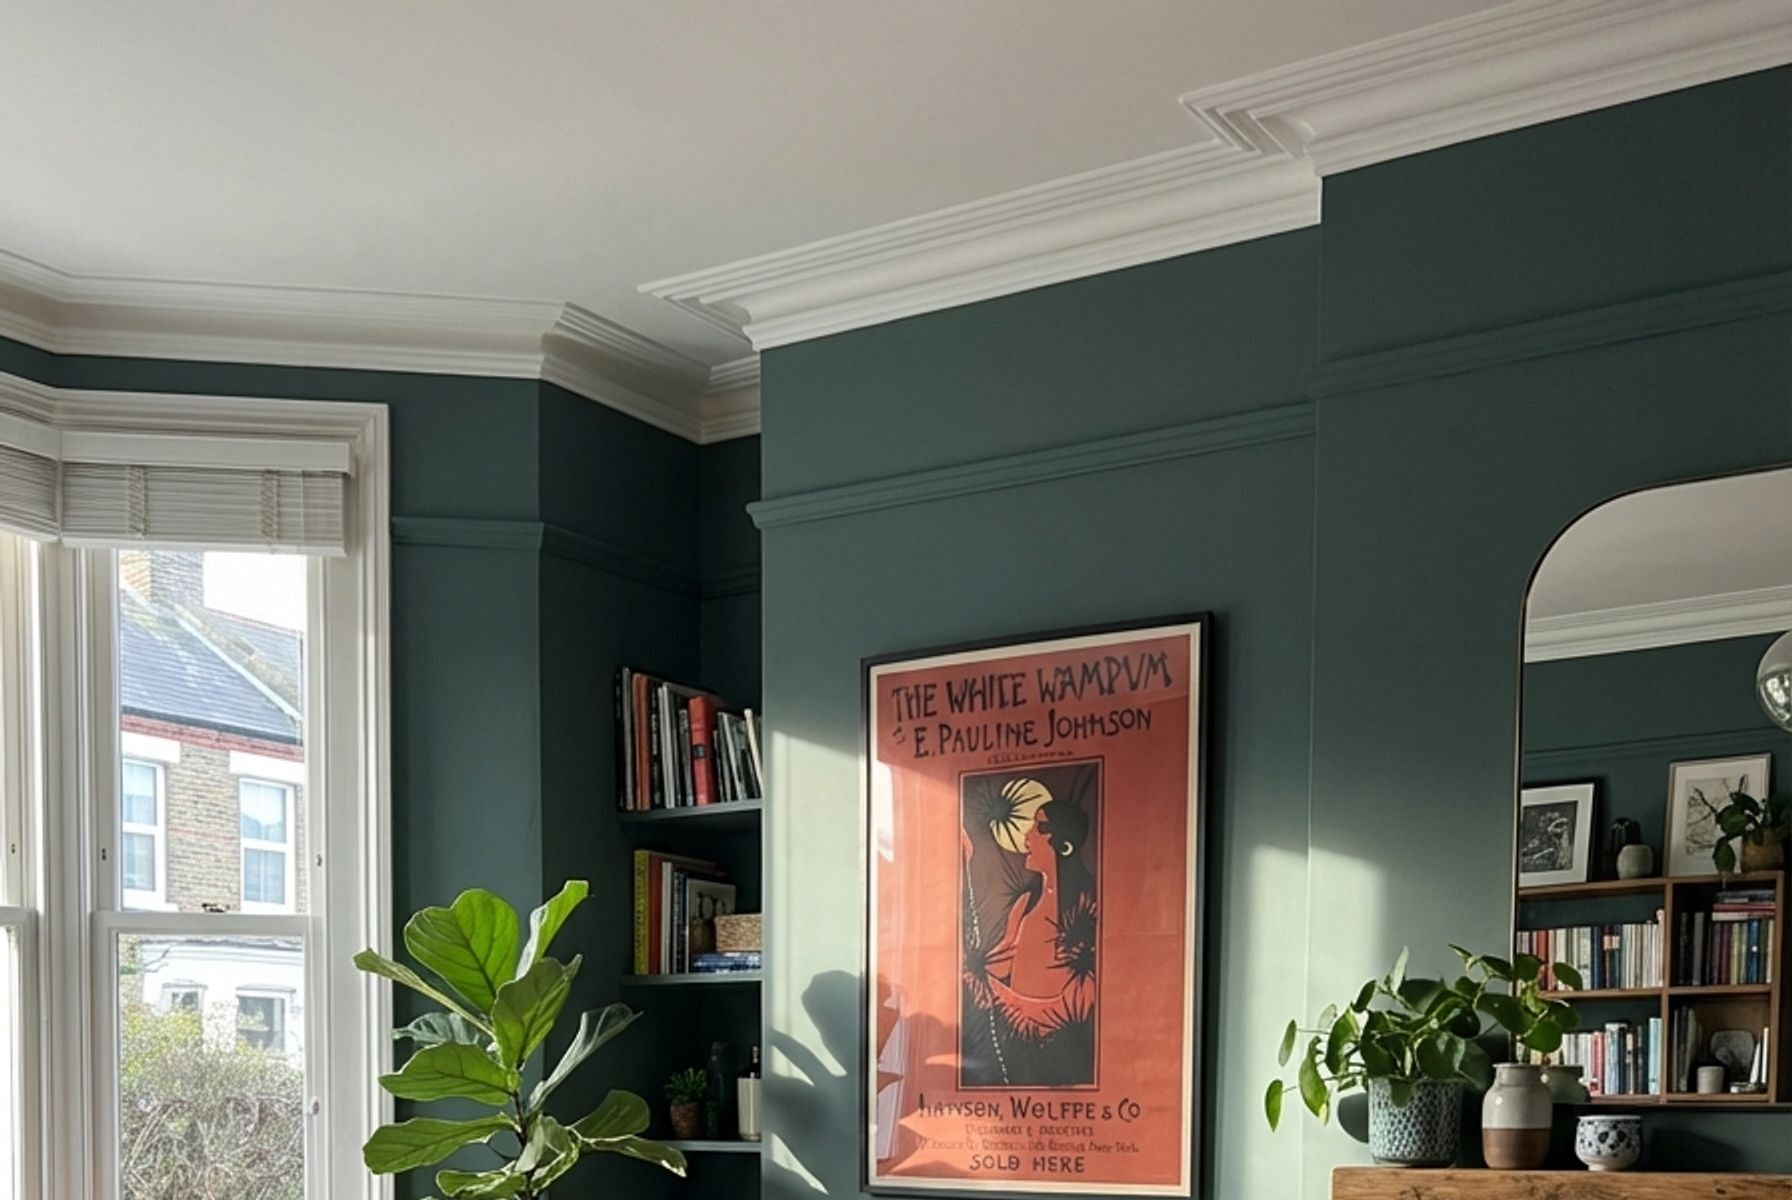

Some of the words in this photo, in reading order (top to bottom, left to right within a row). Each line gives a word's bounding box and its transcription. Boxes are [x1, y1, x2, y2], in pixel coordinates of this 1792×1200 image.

[892, 683, 937, 723] THE
[938, 720, 1038, 756] PAULINE
[1044, 708, 1152, 748] JOHNSON
[1032, 1156, 1086, 1174] HERE
